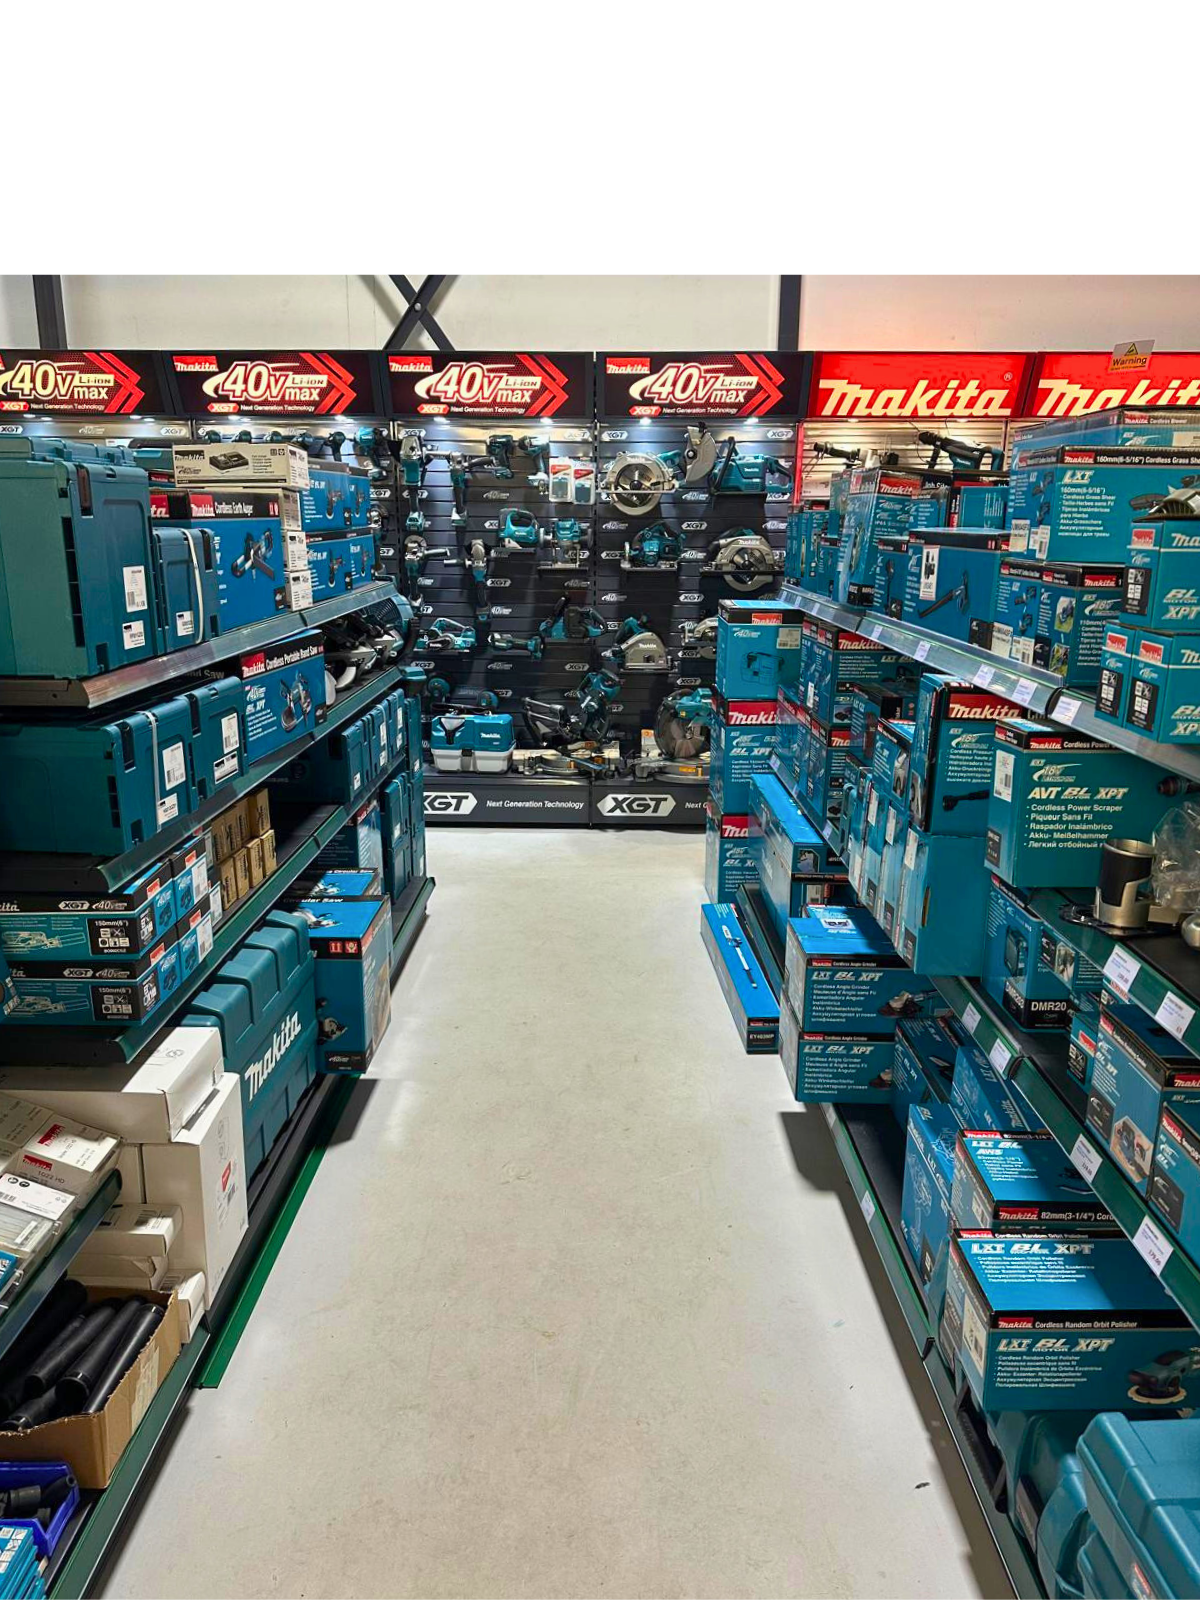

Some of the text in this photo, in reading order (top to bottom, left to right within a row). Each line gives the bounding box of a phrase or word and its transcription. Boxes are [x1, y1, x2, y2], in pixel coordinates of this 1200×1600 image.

[1112, 355, 1147, 367] Warning
[74, 387, 108, 400] max
[284, 387, 319, 400] max
[497, 389, 531, 402] max
[711, 389, 746, 402] max
[2, 403, 27, 411] XGT
[73, 404, 105, 412] Technology
[212, 403, 236, 411] XGT
[284, 404, 315, 412] Technology
[421, 405, 446, 413] XGT
[494, 406, 525, 414] Technology
[633, 406, 658, 415] XGT
[707, 407, 738, 415] Technology
[1062, 470, 1094, 484] LXT
[950, 704, 1021, 719] Makita
[1027, 787, 1061, 799] AVT
[1094, 788, 1129, 799] XPT
[486, 800, 584, 810] Next Generation Technology
[607, 796, 669, 813] XGT
[1093, 804, 1123, 812] Scraper
[1030, 813, 1060, 822] Piqueur
[999, 1211, 1038, 1220] Makita
[971, 1243, 1005, 1254] LXT
[1053, 1243, 1094, 1254] XPT
[996, 1338, 1032, 1352] LXT
[1072, 1338, 1115, 1352] XPT
